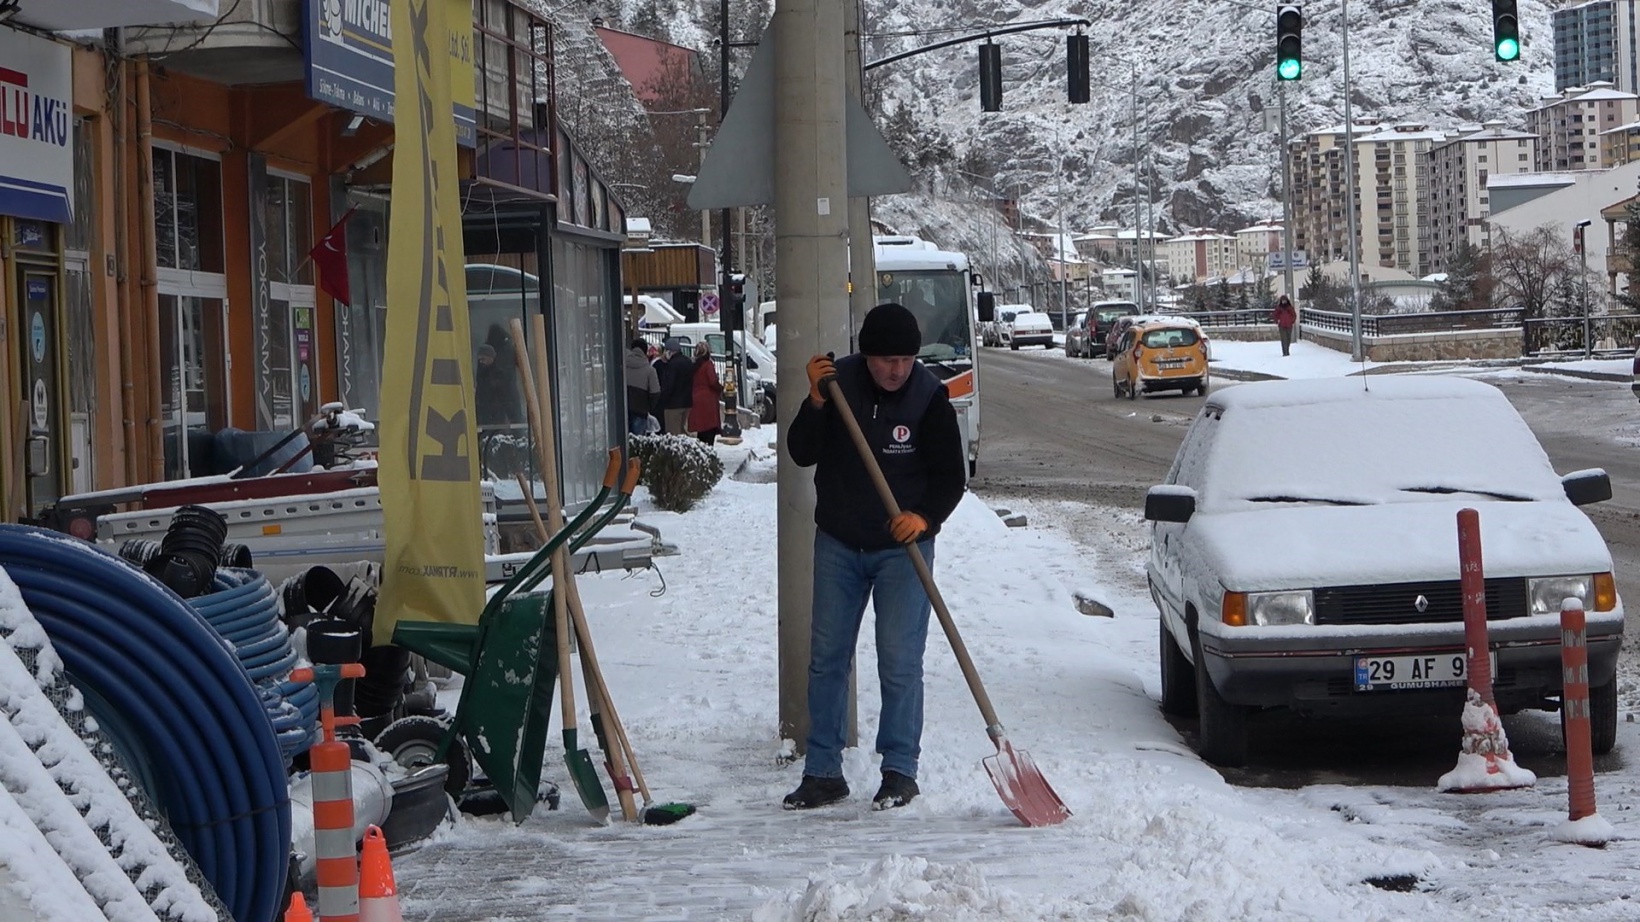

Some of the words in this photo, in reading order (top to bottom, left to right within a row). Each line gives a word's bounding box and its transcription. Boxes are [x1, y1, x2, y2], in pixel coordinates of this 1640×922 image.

[0, 86, 29, 139] LU
[33, 95, 67, 147] AKÜ
[258, 241, 271, 395] YOKOHAMA
[897, 427, 908, 440] P
[1359, 673, 1368, 681] TR
[1369, 660, 1395, 681] 29
[1412, 658, 1436, 679] AF
